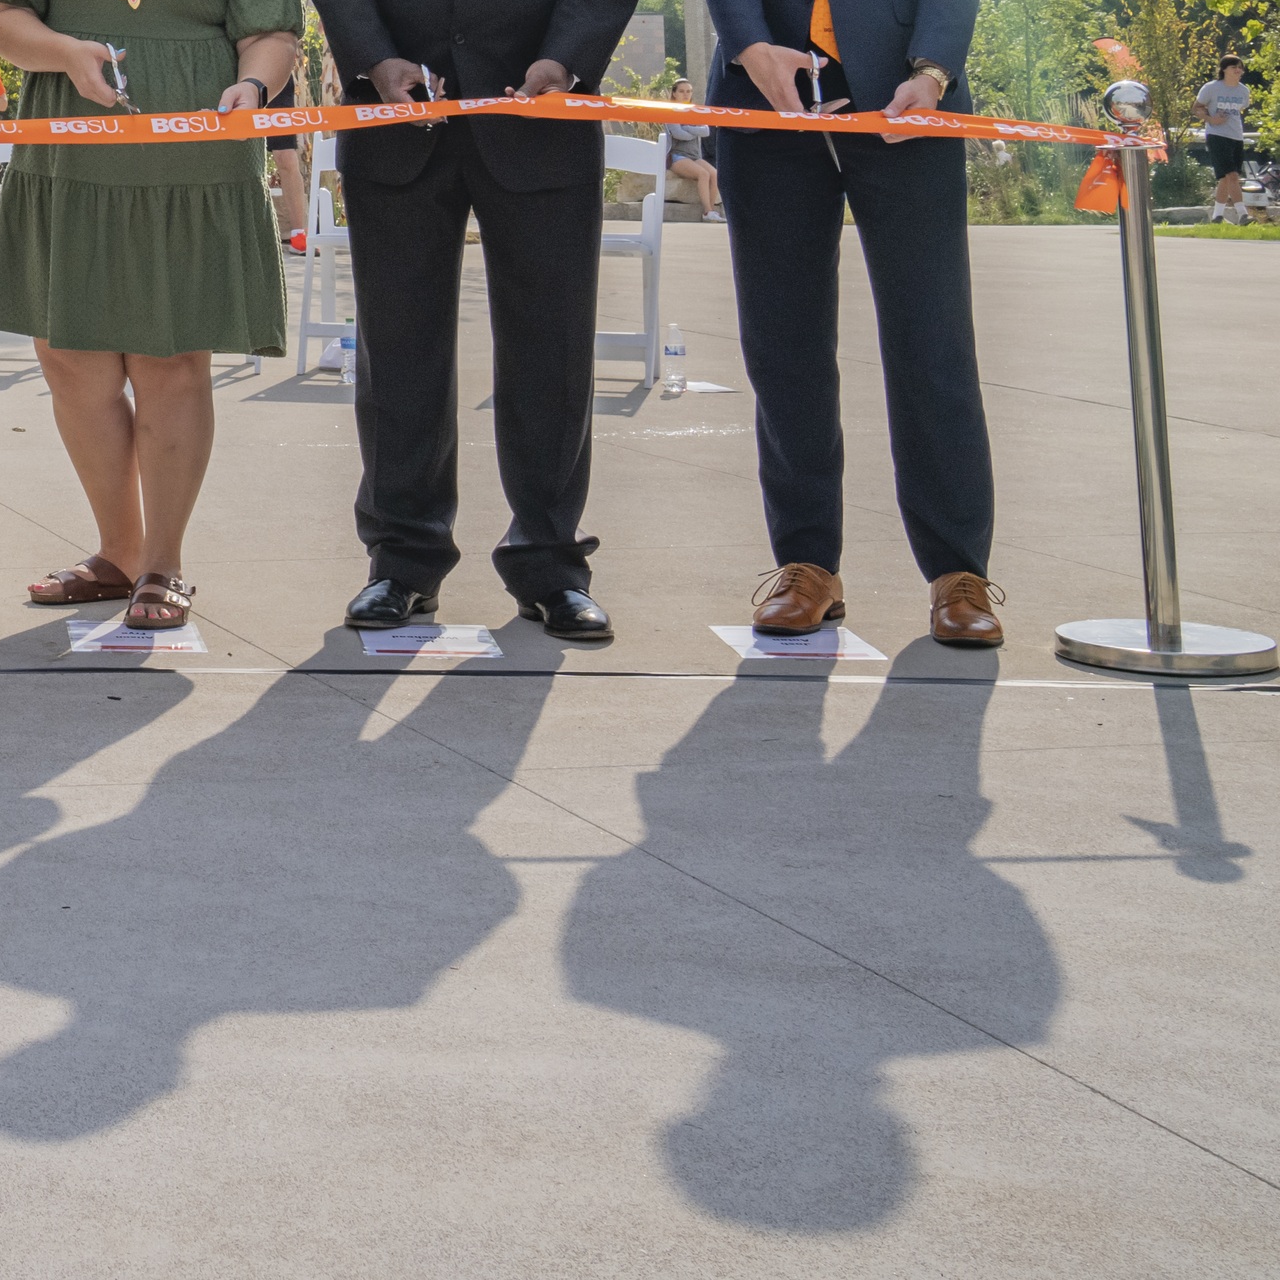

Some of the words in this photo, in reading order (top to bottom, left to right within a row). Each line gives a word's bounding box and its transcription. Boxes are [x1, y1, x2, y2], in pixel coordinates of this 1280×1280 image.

[49, 119, 119, 134] BGSU
[150, 116, 220, 133] BGSU
[252, 110, 322, 129] BGSU
[355, 103, 426, 121] BGSU
